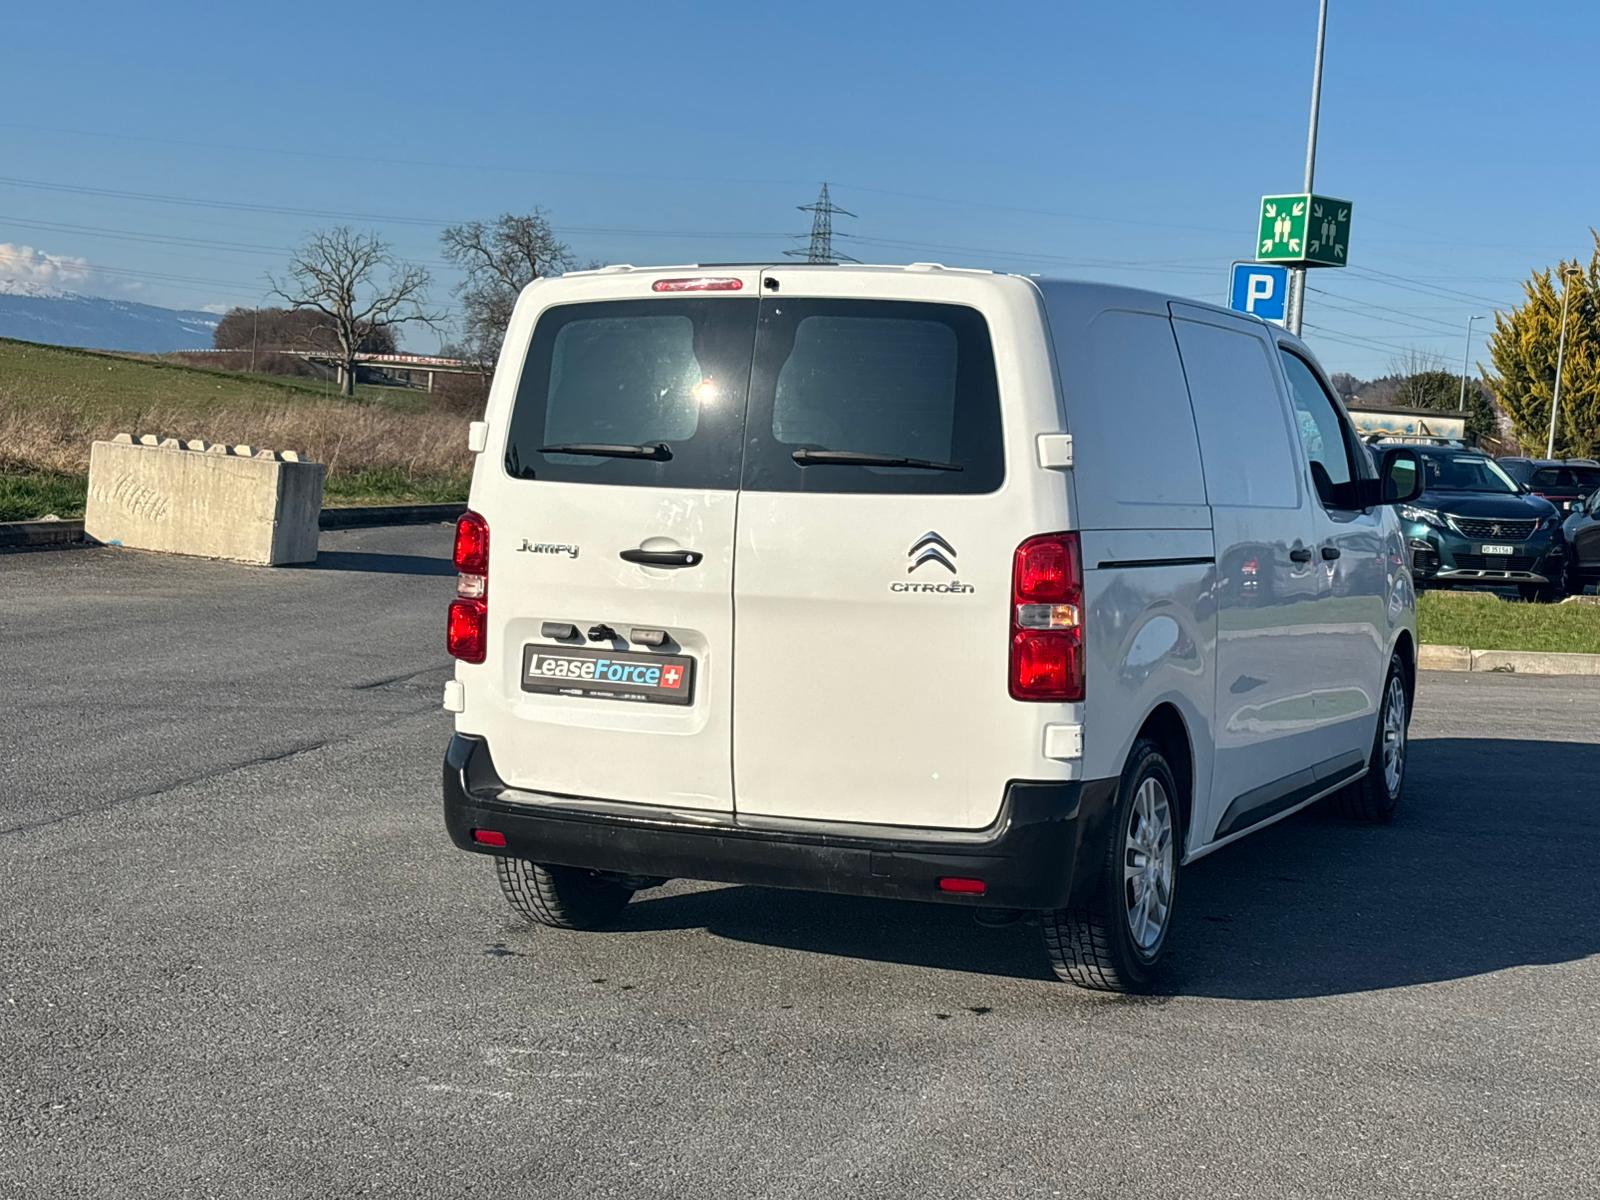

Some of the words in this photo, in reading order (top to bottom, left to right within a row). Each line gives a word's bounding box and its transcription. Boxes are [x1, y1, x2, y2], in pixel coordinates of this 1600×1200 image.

[1246, 273, 1274, 312] P
[516, 538, 580, 559] Jumpy
[529, 653, 661, 685] LeaseForce
